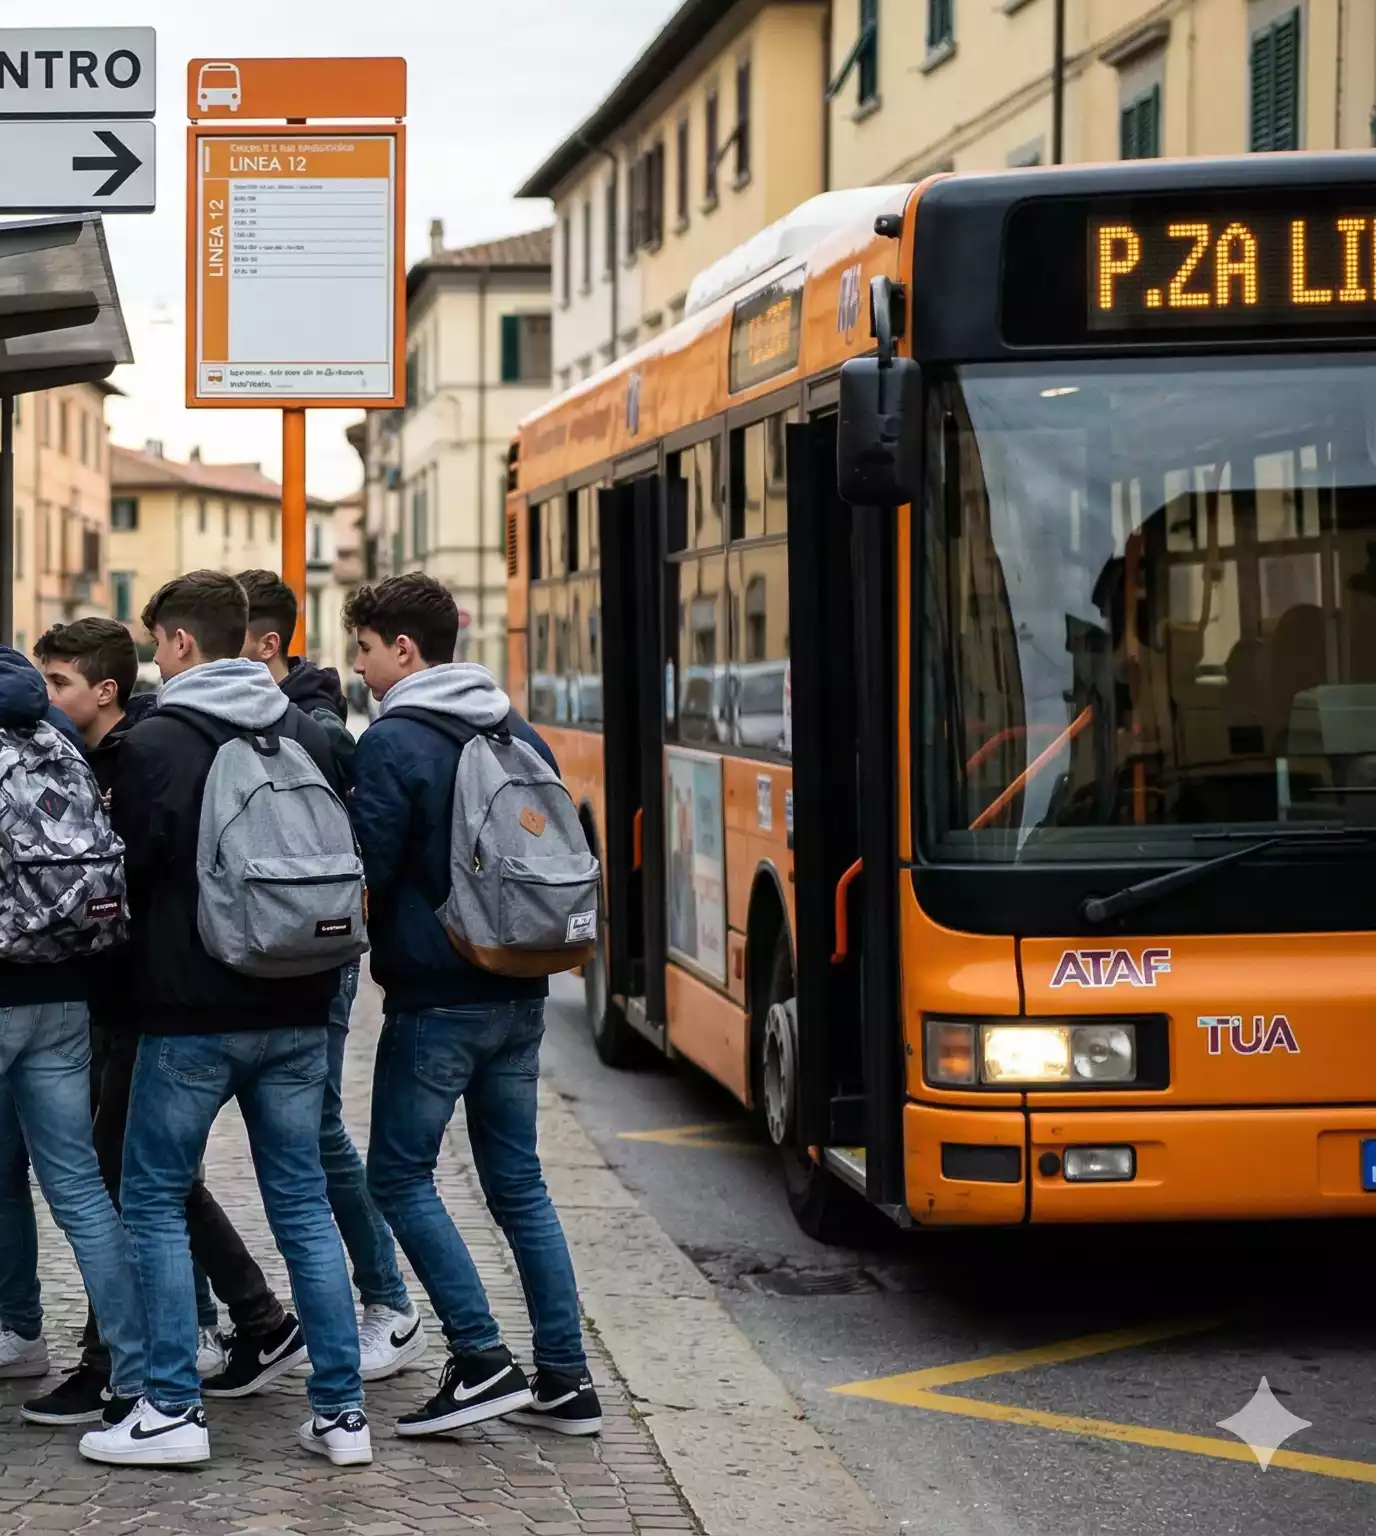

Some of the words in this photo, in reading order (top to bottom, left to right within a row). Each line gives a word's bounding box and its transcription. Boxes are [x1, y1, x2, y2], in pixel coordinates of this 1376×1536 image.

[229, 156, 282, 172] LINEA
[288, 156, 306, 172] 12
[208, 199, 224, 219] 12
[208, 224, 224, 277] LINEA
[1099, 222, 1256, 309] P.ZA
[1292, 218, 1376, 304] LI
[1049, 948, 1171, 988] ATAF
[1197, 1015, 1300, 1055] TUA
